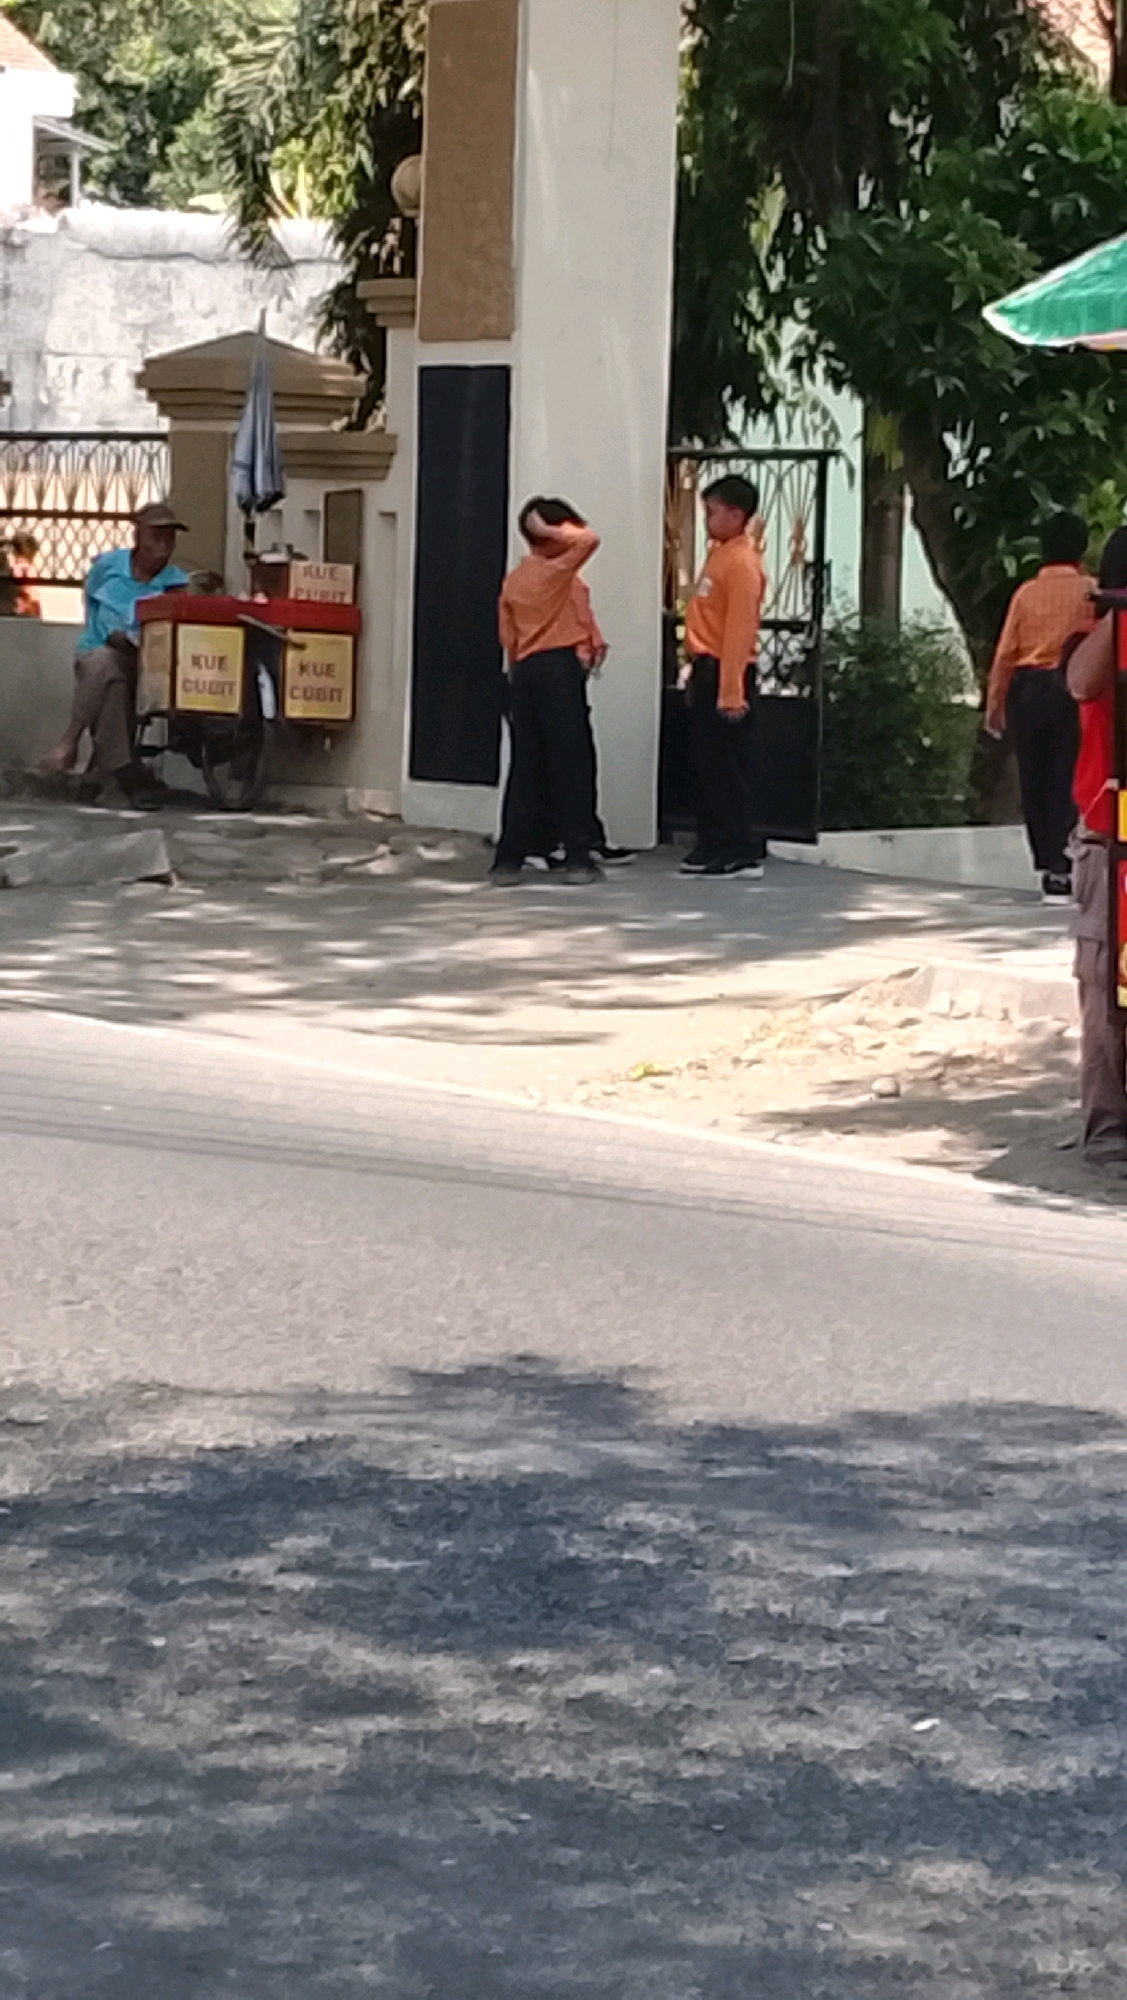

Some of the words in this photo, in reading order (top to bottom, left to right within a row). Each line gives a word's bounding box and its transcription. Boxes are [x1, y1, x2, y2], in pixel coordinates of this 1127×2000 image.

[303, 565, 339, 581] KUE
[191, 654, 228, 672] KUE
[298, 661, 336, 678] KUE
[290, 686, 343, 703] CUBIT
